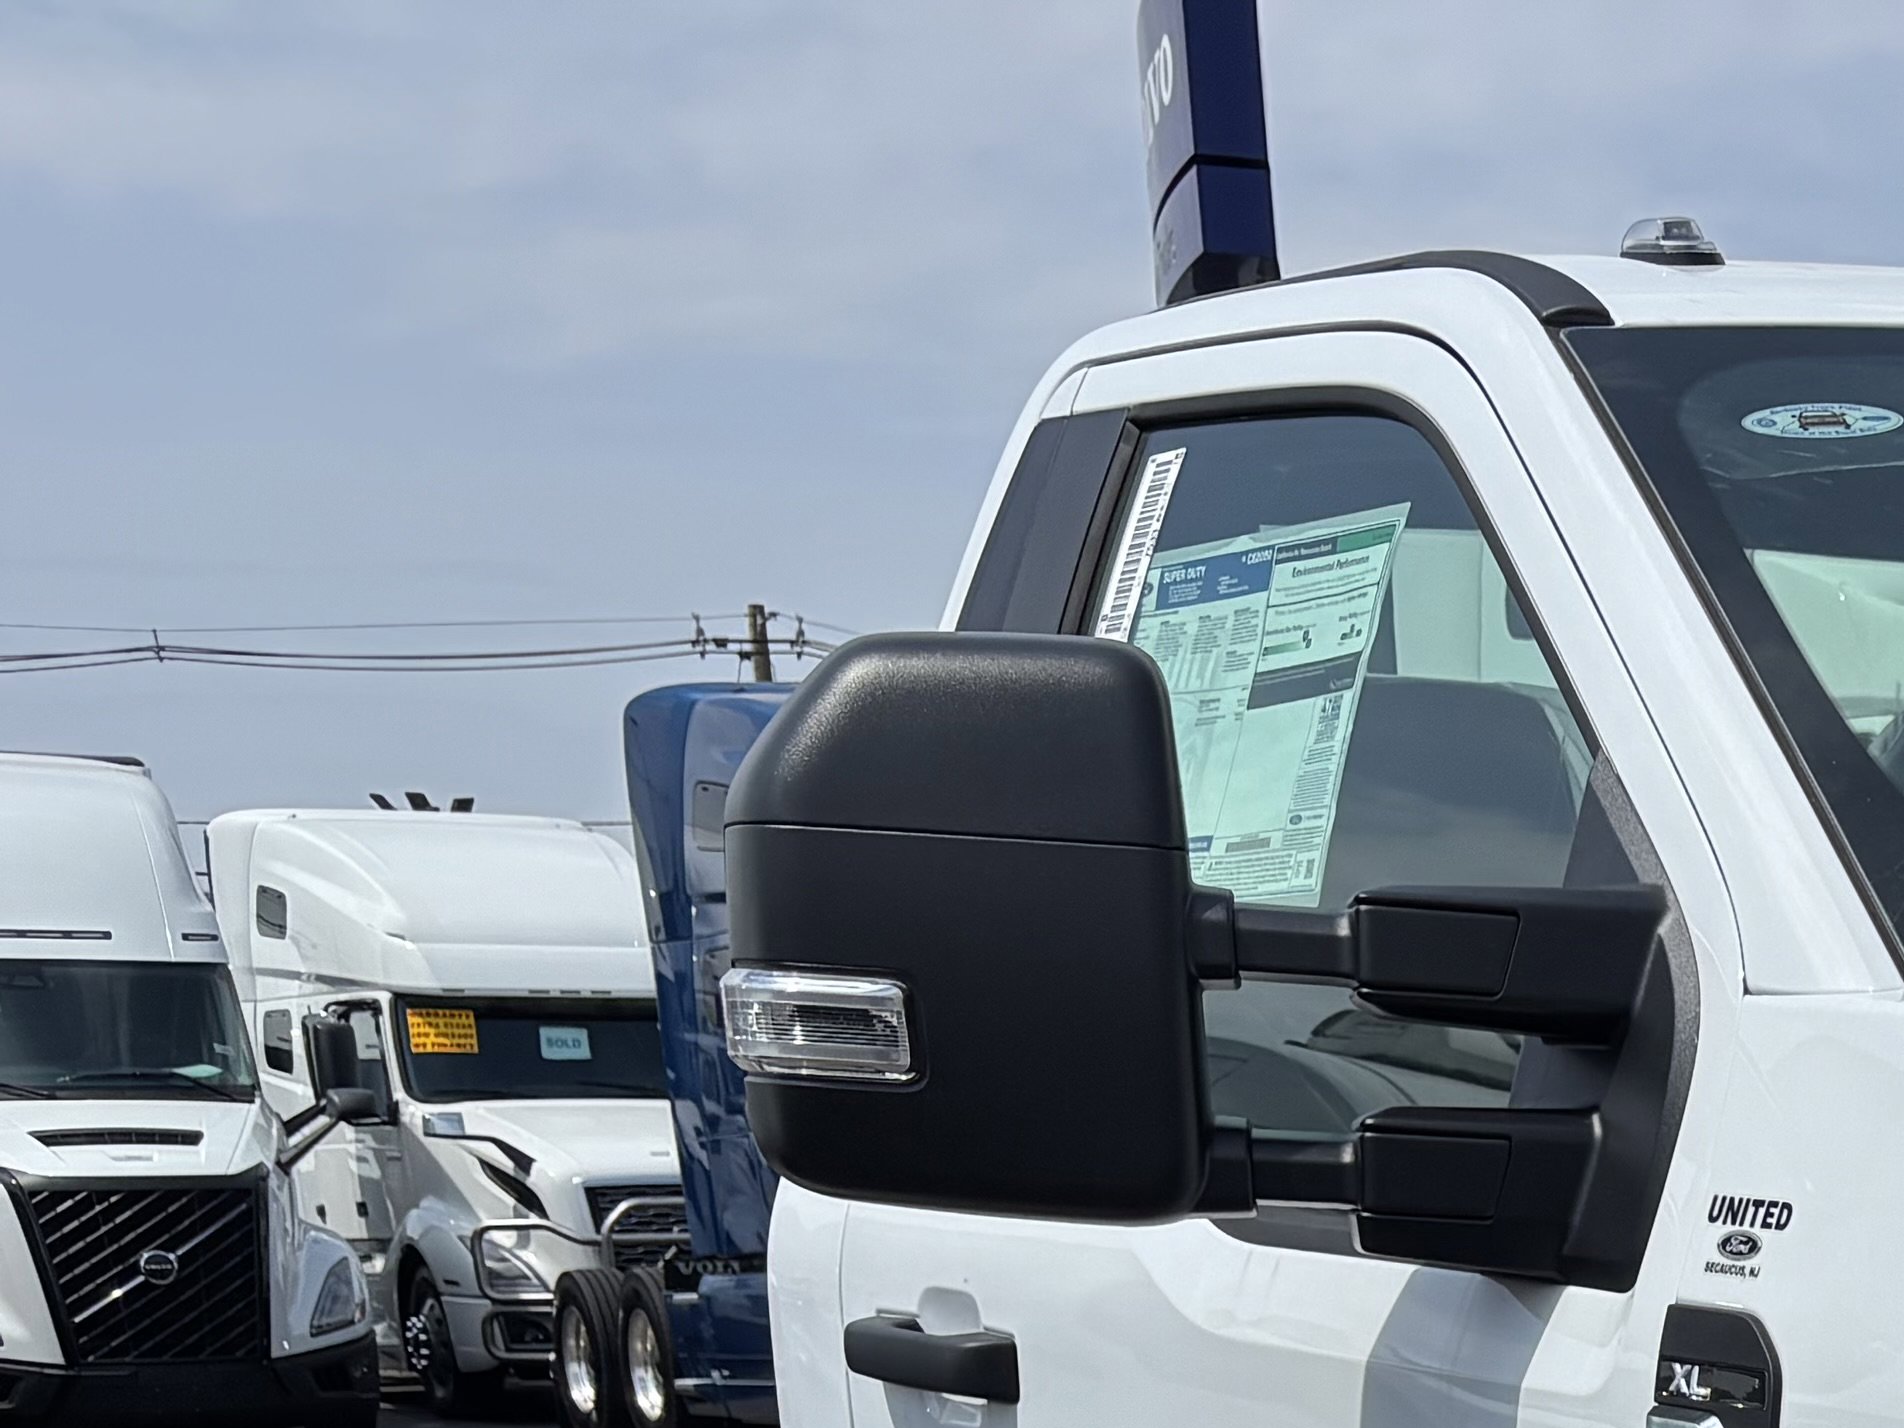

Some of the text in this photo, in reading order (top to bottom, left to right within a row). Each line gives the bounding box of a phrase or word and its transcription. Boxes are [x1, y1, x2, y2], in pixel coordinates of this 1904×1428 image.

[545, 1037, 582, 1050] SOLD
[1707, 1194, 1793, 1231] UNITED
[1748, 1265, 1761, 1279] NJ
[1668, 1361, 1711, 1401] XL
